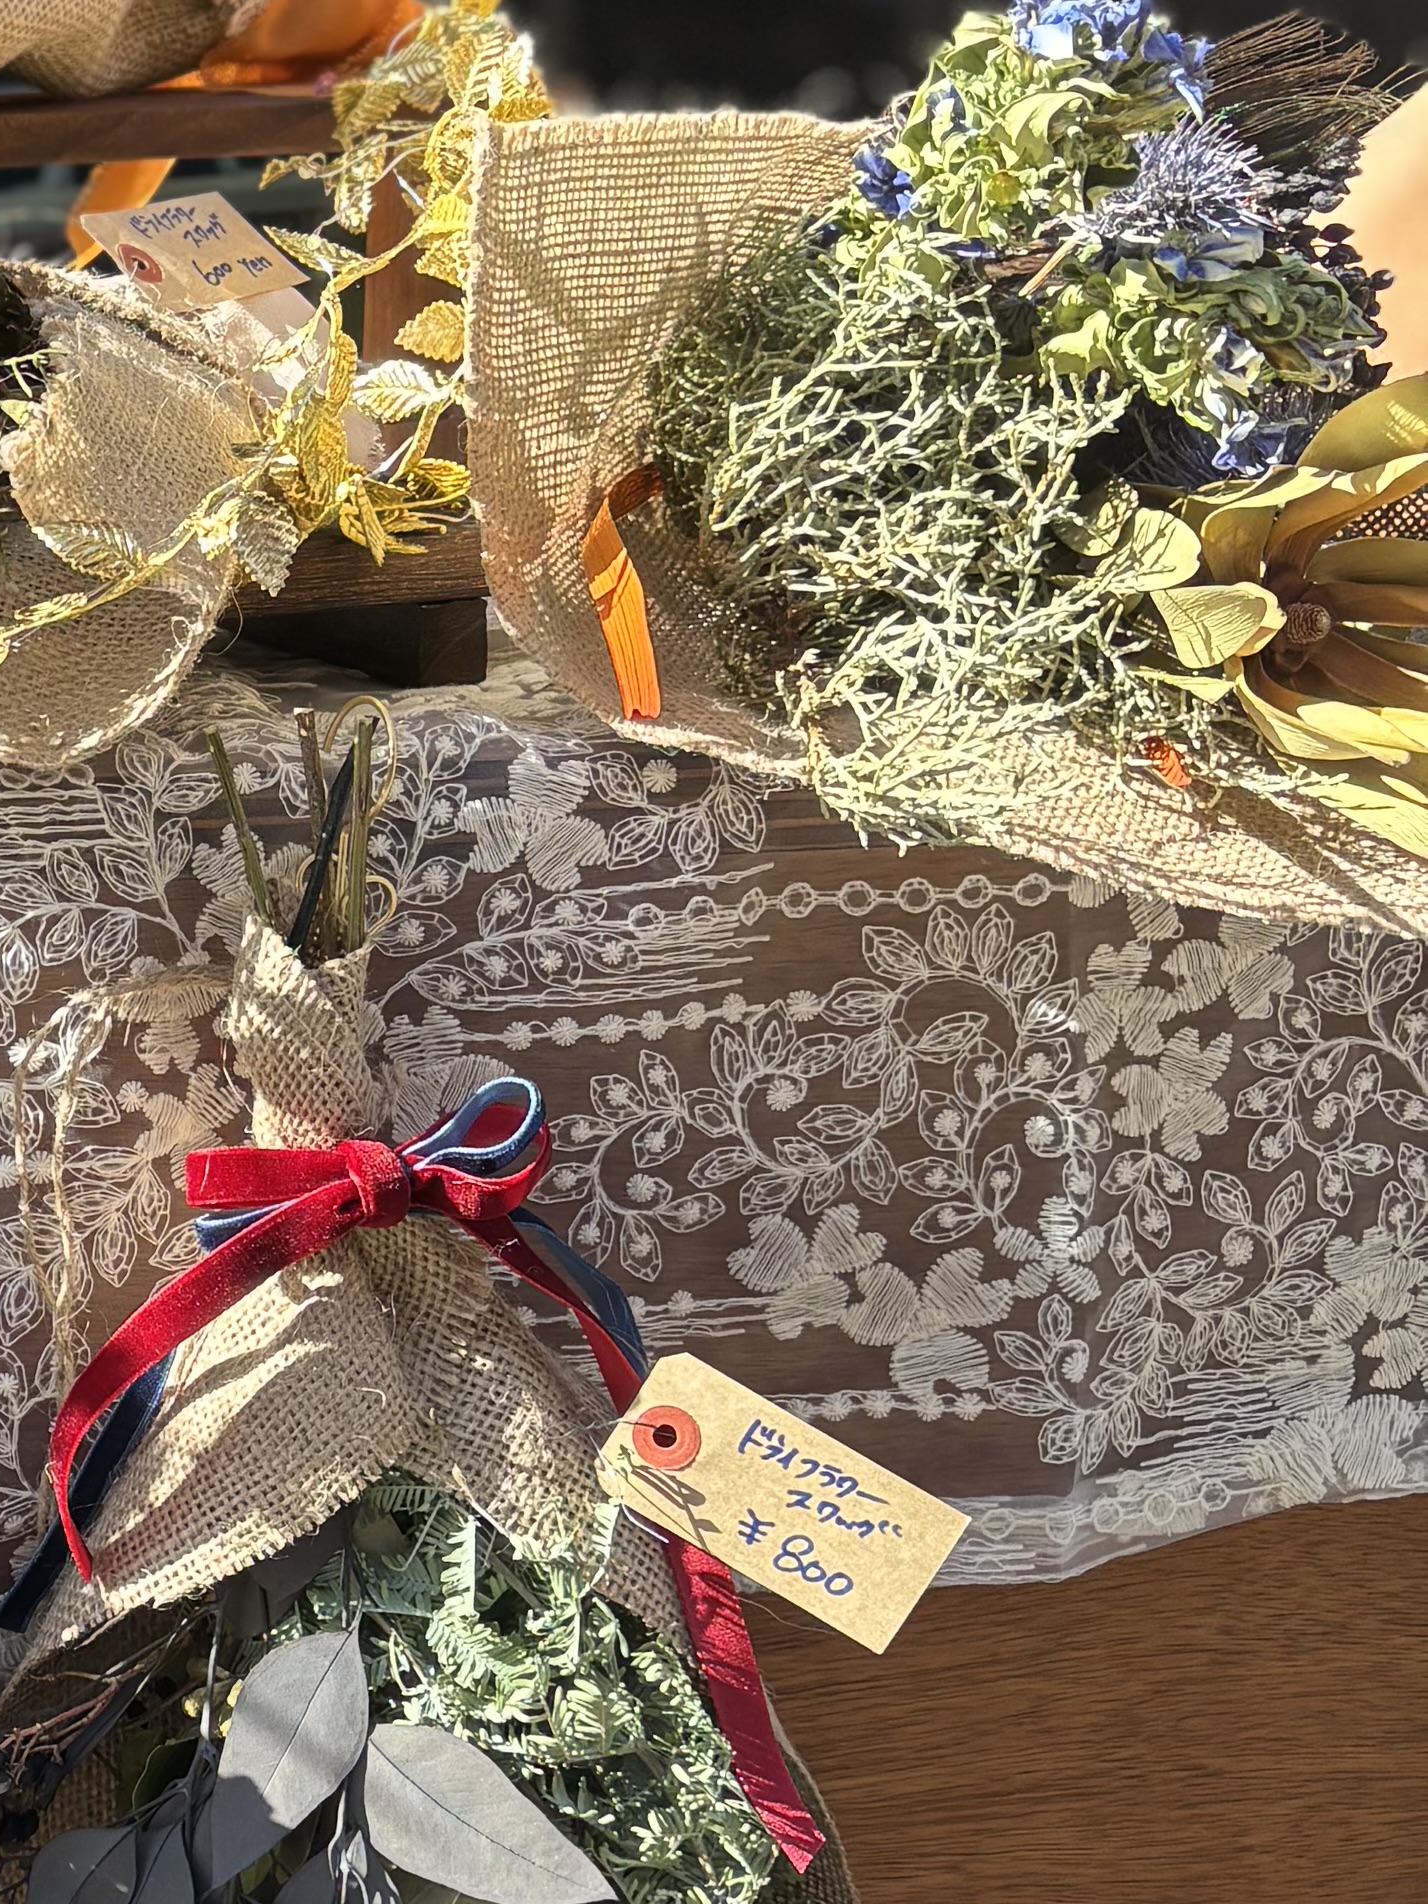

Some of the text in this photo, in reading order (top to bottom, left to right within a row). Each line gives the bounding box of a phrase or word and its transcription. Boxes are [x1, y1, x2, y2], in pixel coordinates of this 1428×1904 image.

[192, 259, 233, 287] 600
[737, 1418, 891, 1505] ドライフラワー
[785, 1489, 903, 1539] スワッグ
